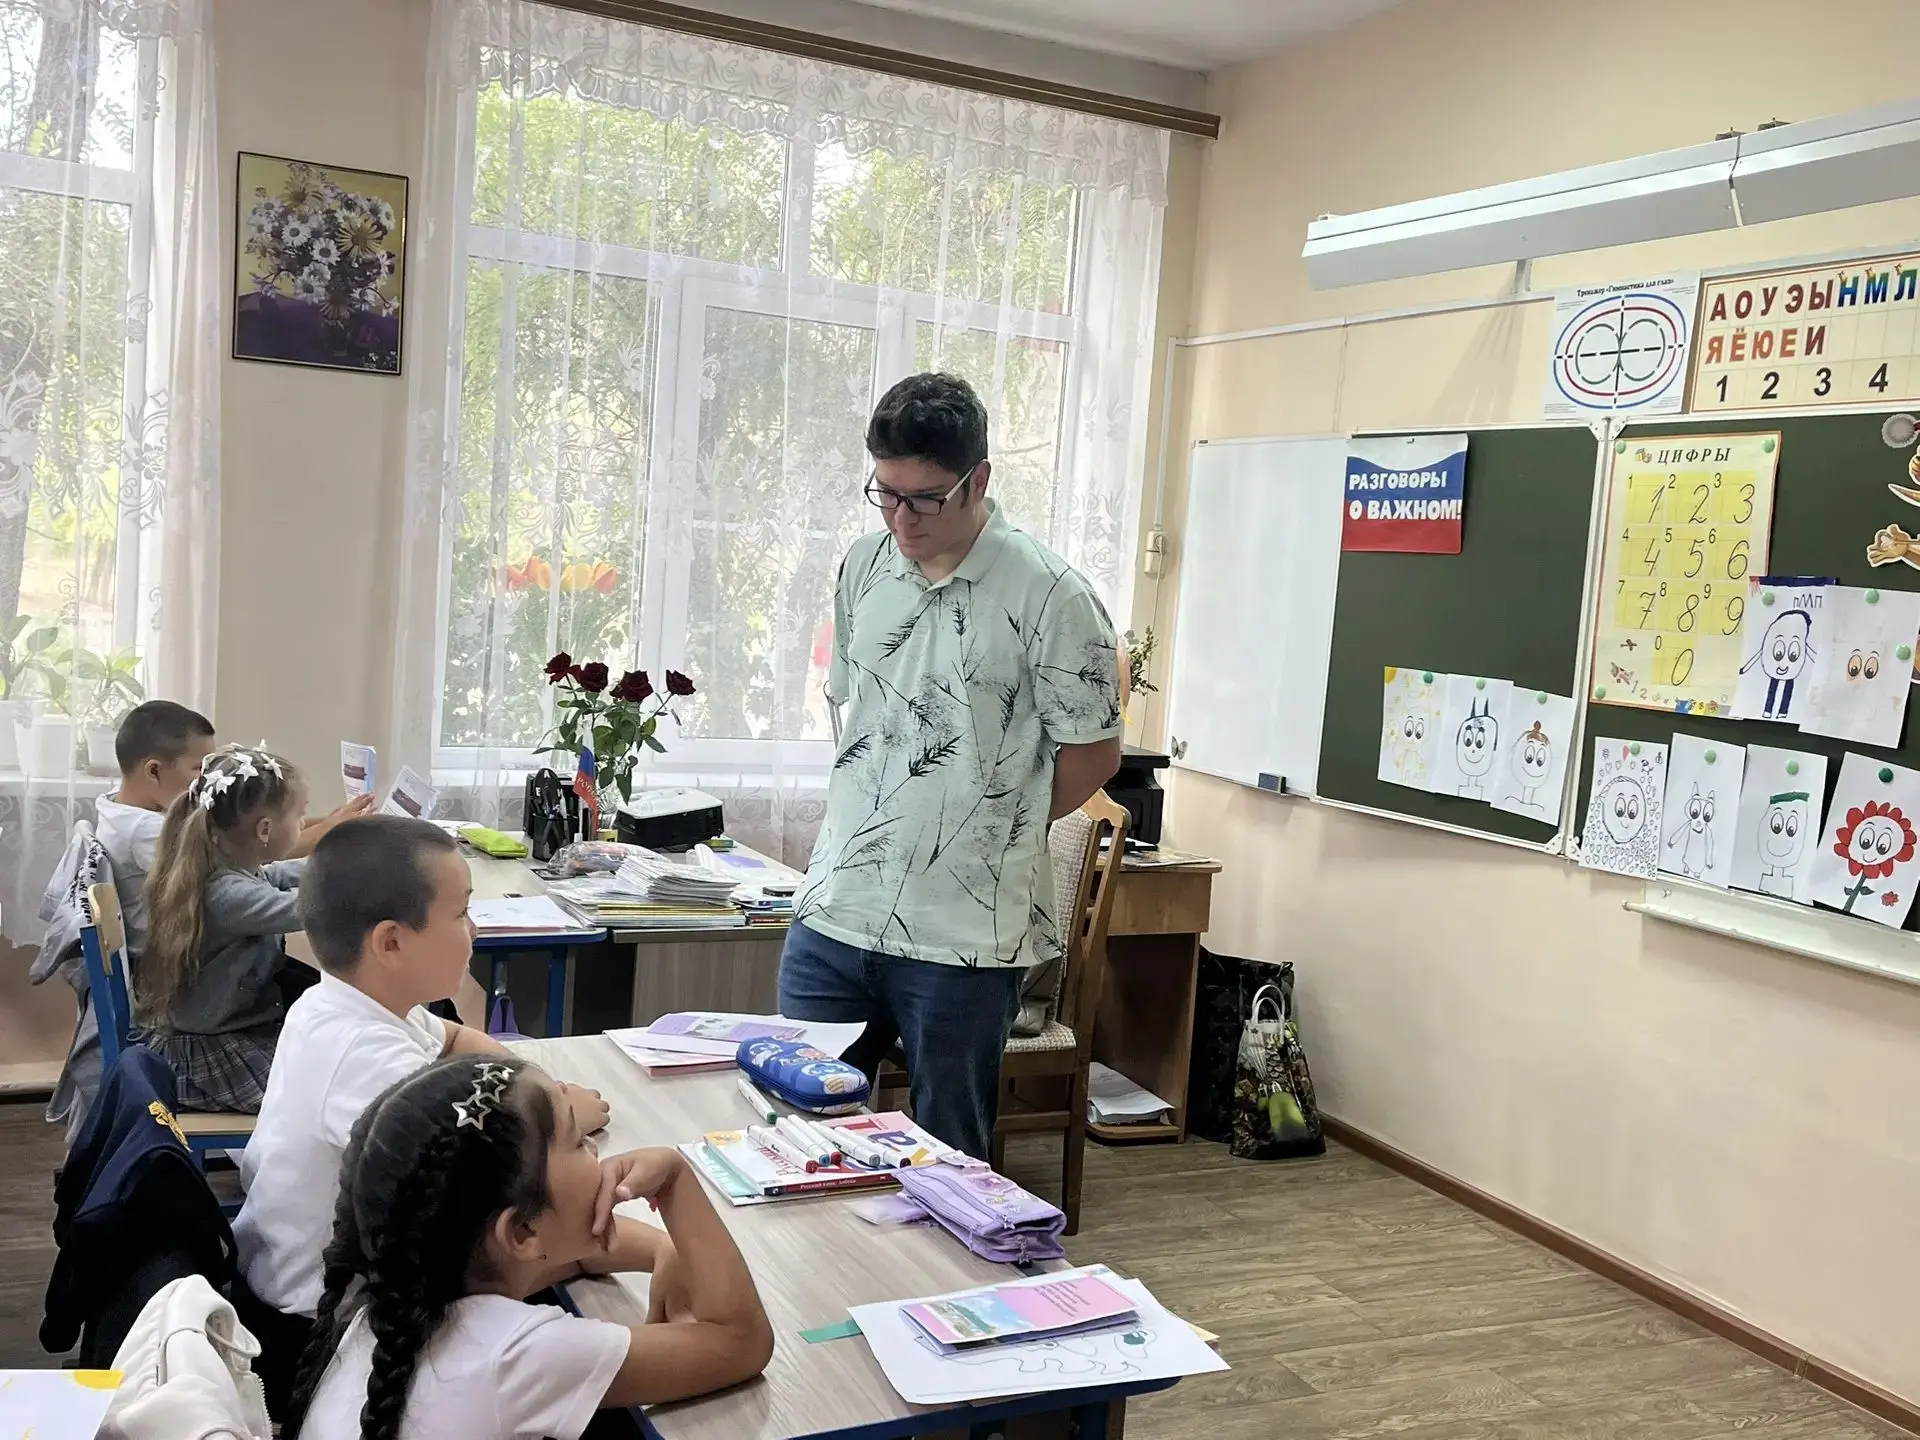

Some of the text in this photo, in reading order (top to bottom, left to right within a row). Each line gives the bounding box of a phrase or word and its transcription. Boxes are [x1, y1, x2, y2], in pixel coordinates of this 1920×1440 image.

[1715, 374, 1728, 403] 1
[1761, 371, 1780, 400] 2
[1814, 367, 1832, 397] 3
[1868, 362, 1889, 393] 4
[1657, 447, 1731, 466] ЦИФРЫ
[1348, 470, 1448, 491] РАЗГОВОРЫ
[1667, 473, 1676, 489] 2
[1713, 472, 1722, 488] 3
[1348, 499, 1461, 520] О ВАЖНОМ!
[1649, 483, 1755, 524] 1 2 3
[1664, 528, 1673, 543] 5
[1708, 528, 1716, 544] 6
[1644, 538, 1750, 580] 4 5 6
[1660, 581, 1667, 597] 8
[1703, 583, 1712, 599] 9
[1639, 591, 1745, 636] 7 8 9
